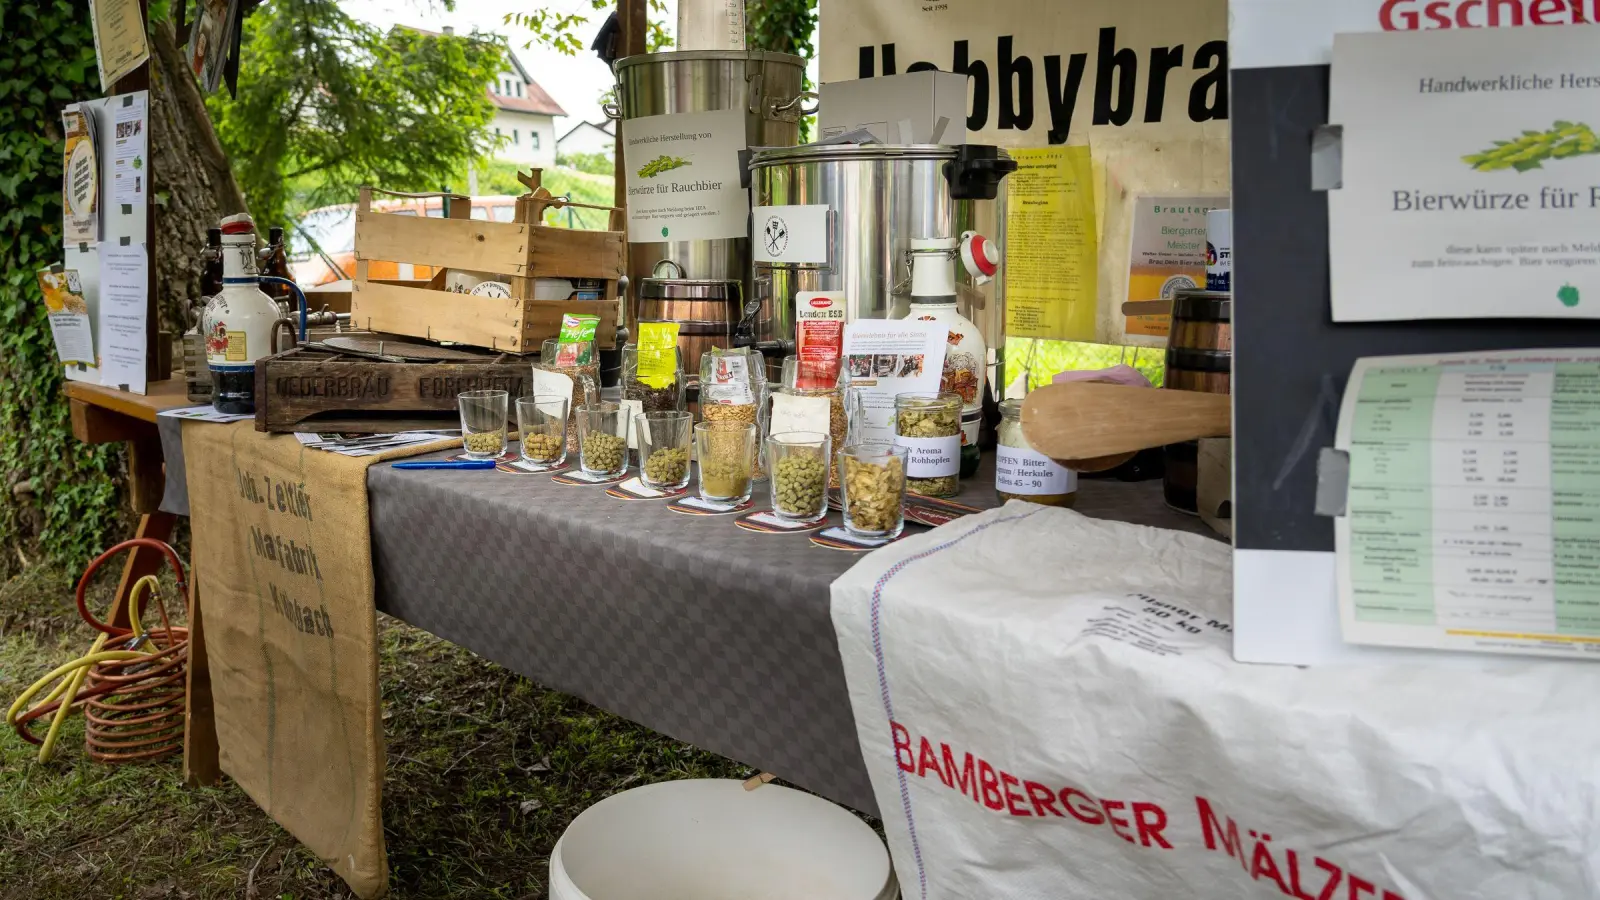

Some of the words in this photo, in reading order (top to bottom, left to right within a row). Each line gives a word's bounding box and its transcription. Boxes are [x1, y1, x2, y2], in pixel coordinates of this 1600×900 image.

[859, 26, 1229, 145] bbybra
[1419, 76, 1553, 93] Handwerkliche
[661, 132, 697, 143] Herstellung
[656, 184, 669, 194] für
[671, 180, 722, 193] Rauchbier
[1392, 188, 1529, 212] Bierwürze
[1540, 186, 1579, 207] für
[1167, 241, 1200, 250] Meister
[800, 310, 826, 318] London
[828, 310, 843, 318] ESB
[916, 447, 942, 455] Aroma
[911, 457, 951, 465] Rohhopfen
[998, 456, 1018, 465] OPFEN
[1023, 459, 1046, 467] Bitter
[889, 719, 1174, 850] BAMBERGER
[1195, 796, 1408, 900] MÄLZE
